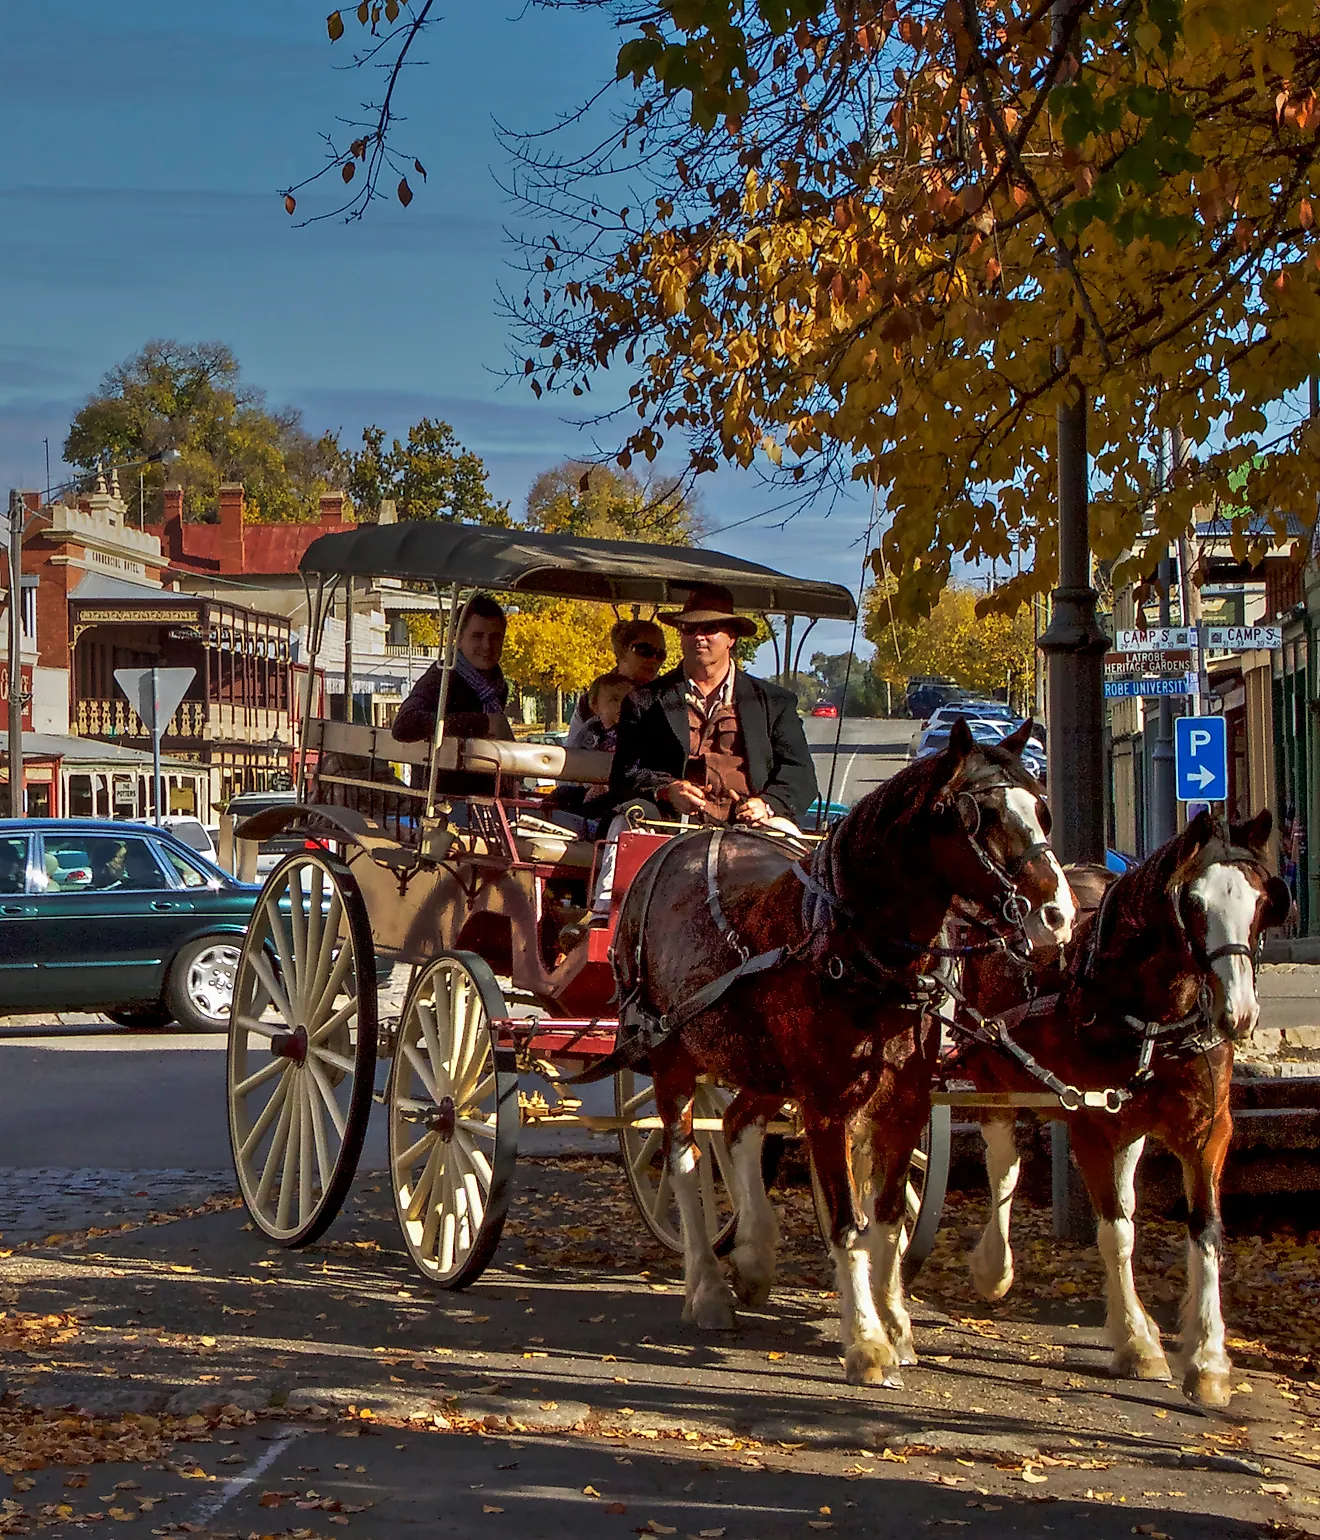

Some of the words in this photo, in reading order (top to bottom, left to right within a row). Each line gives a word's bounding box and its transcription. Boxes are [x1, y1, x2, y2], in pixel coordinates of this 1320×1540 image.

[1122, 629, 1156, 644] CAMP
[1227, 628, 1262, 641] CAMP
[1126, 652, 1166, 663] LATROBE
[1104, 662, 1146, 674] HERITAGE
[1149, 659, 1191, 672] GARDENS
[1104, 682, 1130, 697] ROBE
[1133, 680, 1191, 696] UNIVERSITY
[1190, 730, 1211, 757] P
